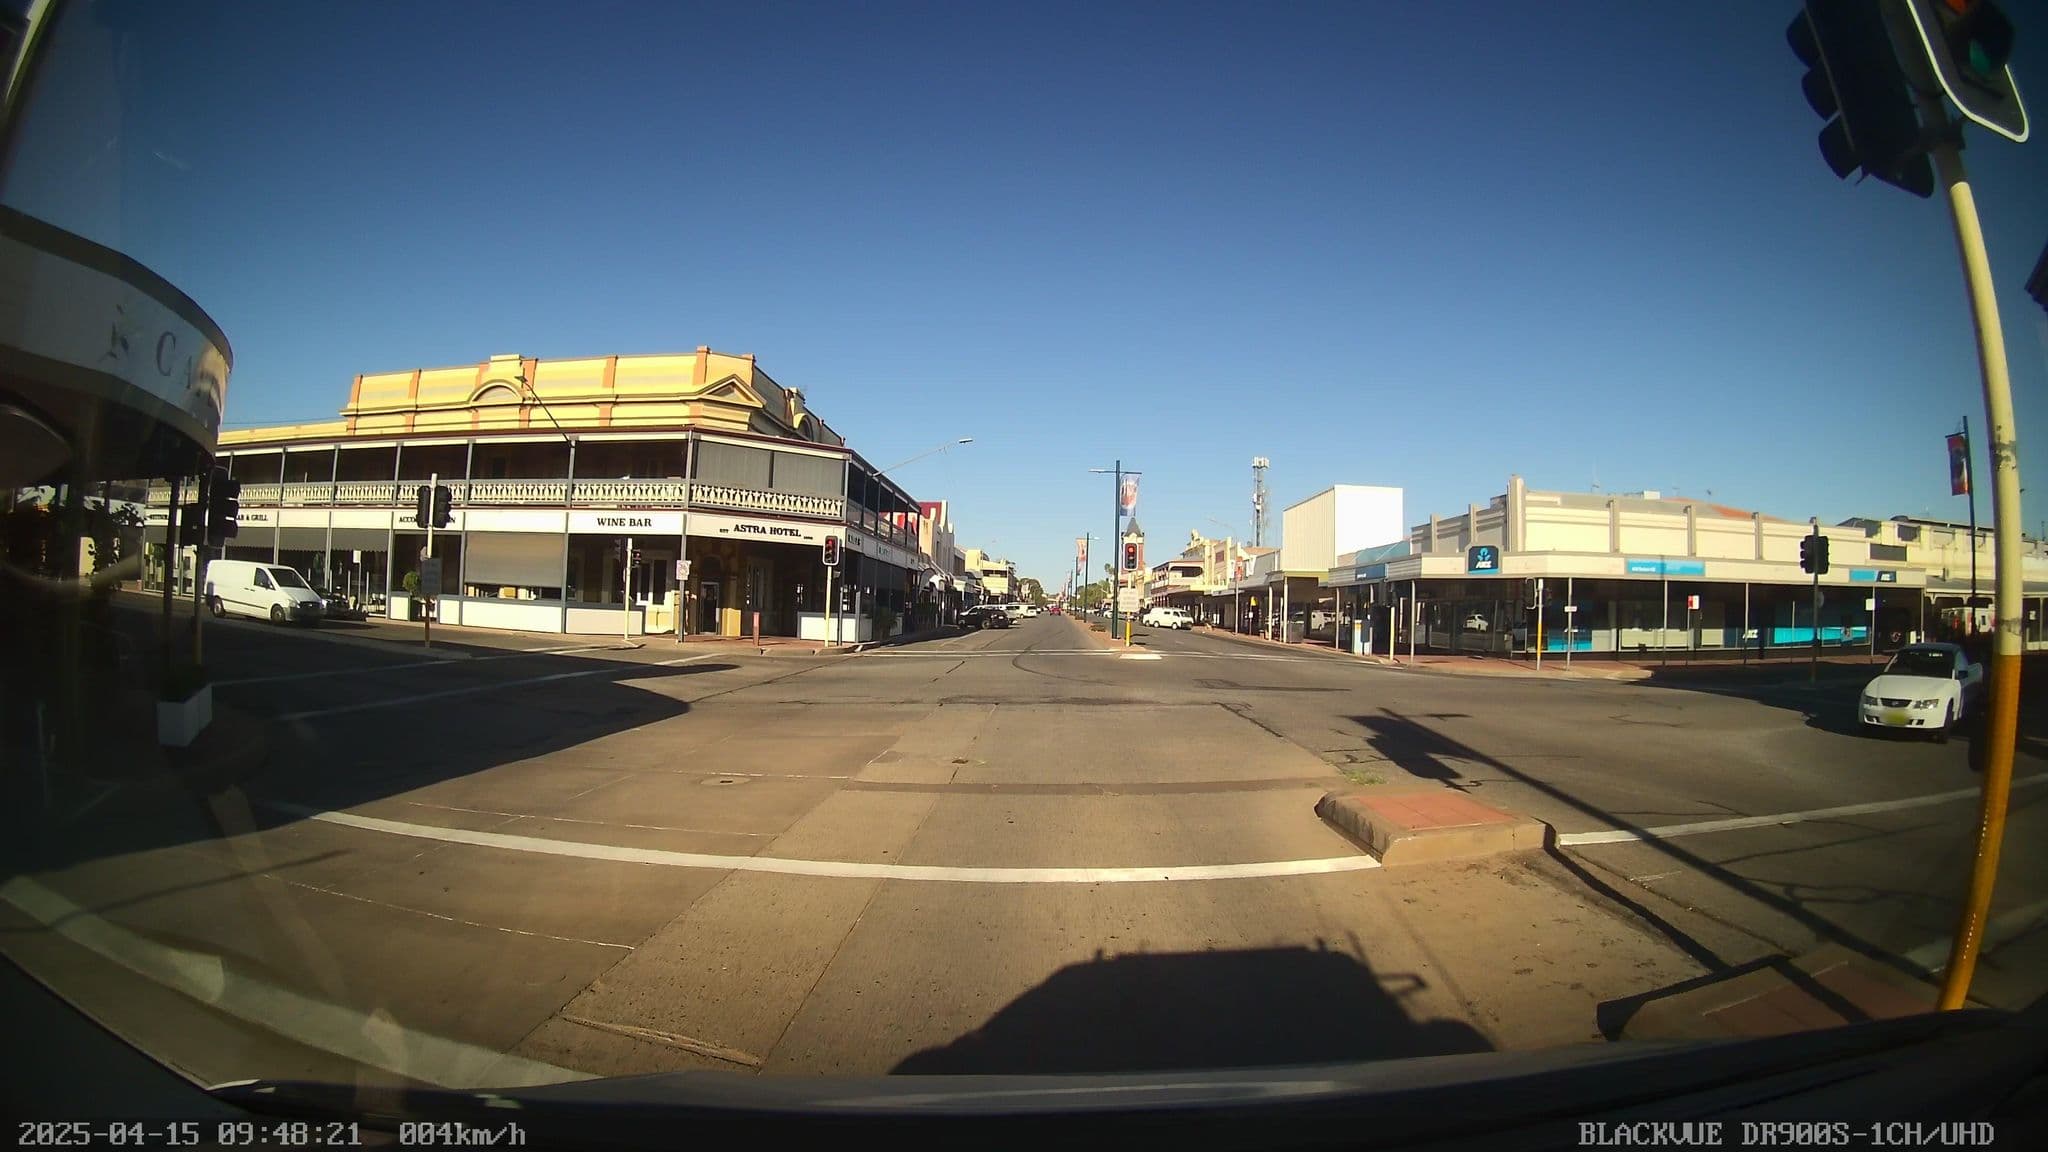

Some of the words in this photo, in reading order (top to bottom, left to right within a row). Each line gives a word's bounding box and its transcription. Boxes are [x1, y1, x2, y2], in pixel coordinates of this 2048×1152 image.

[597, 517, 626, 527] WINE
[629, 518, 652, 527] BAR
[733, 524, 767, 535] ASTRA
[769, 526, 802, 537] HOTEL
